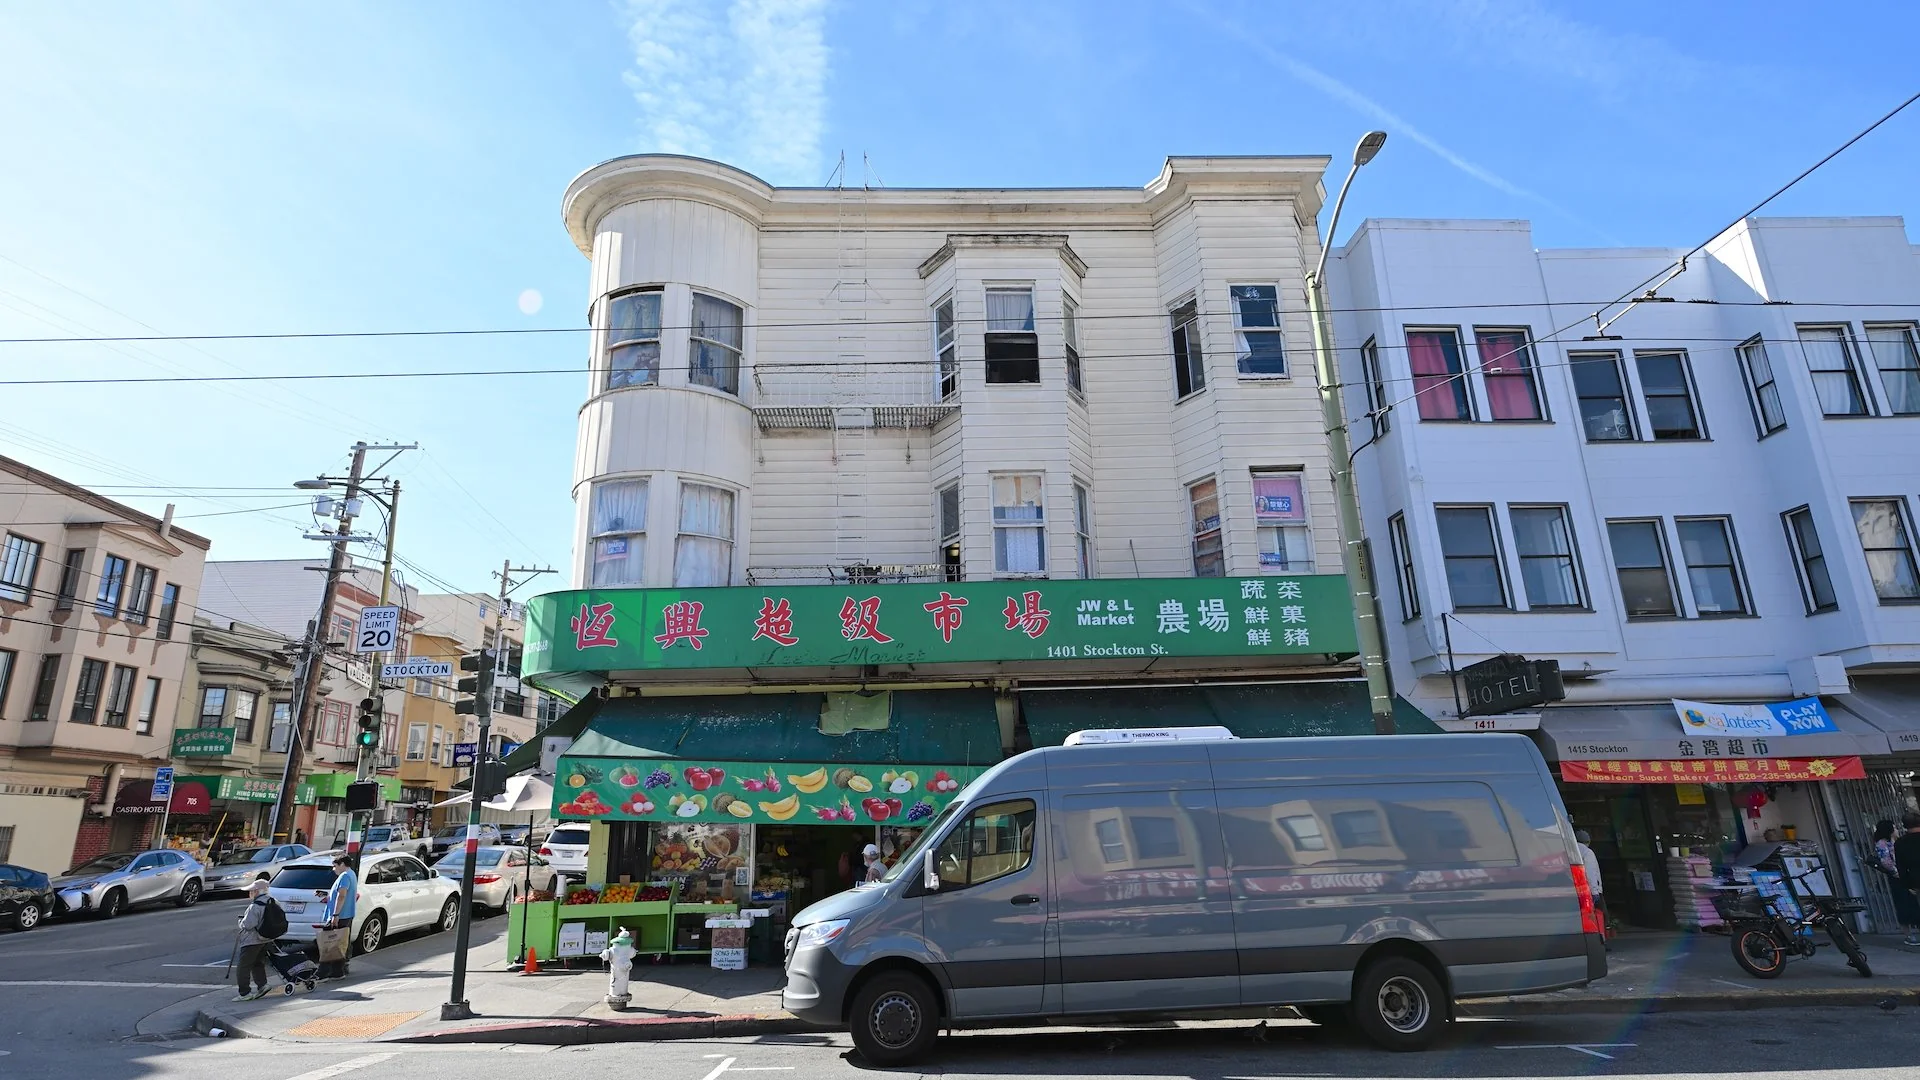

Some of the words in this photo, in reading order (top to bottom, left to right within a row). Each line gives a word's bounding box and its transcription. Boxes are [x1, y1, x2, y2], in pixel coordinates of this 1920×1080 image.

[1077, 600, 1100, 612] JW
[1106, 600, 1119, 612] &
[1123, 600, 1135, 612] L
[364, 611, 396, 620] SPEED
[570, 590, 1052, 652] 恆興超級市場
[1077, 612, 1135, 627] Market
[1156, 599, 1230, 635] 農場
[365, 620, 391, 629] LIMIT
[361, 630, 391, 648] 20
[1047, 643, 1077, 658] 1401
[1083, 642, 1147, 657] Stockton
[1150, 642, 1169, 657] St.
[385, 664, 449, 676] STOCKTON
[1468, 674, 1536, 707] HOTEL
[1780, 702, 1818, 720] PLAY
[1474, 720, 1496, 729] 1411
[1787, 714, 1826, 730] NOW
[1899, 734, 1919, 743] 1419
[1568, 745, 1588, 754] 1415
[1590, 744, 1629, 754] Stockton
[1640, 774, 1668, 782] Super
[1673, 774, 1710, 783] Bakery
[187, 797, 198, 806] 705
